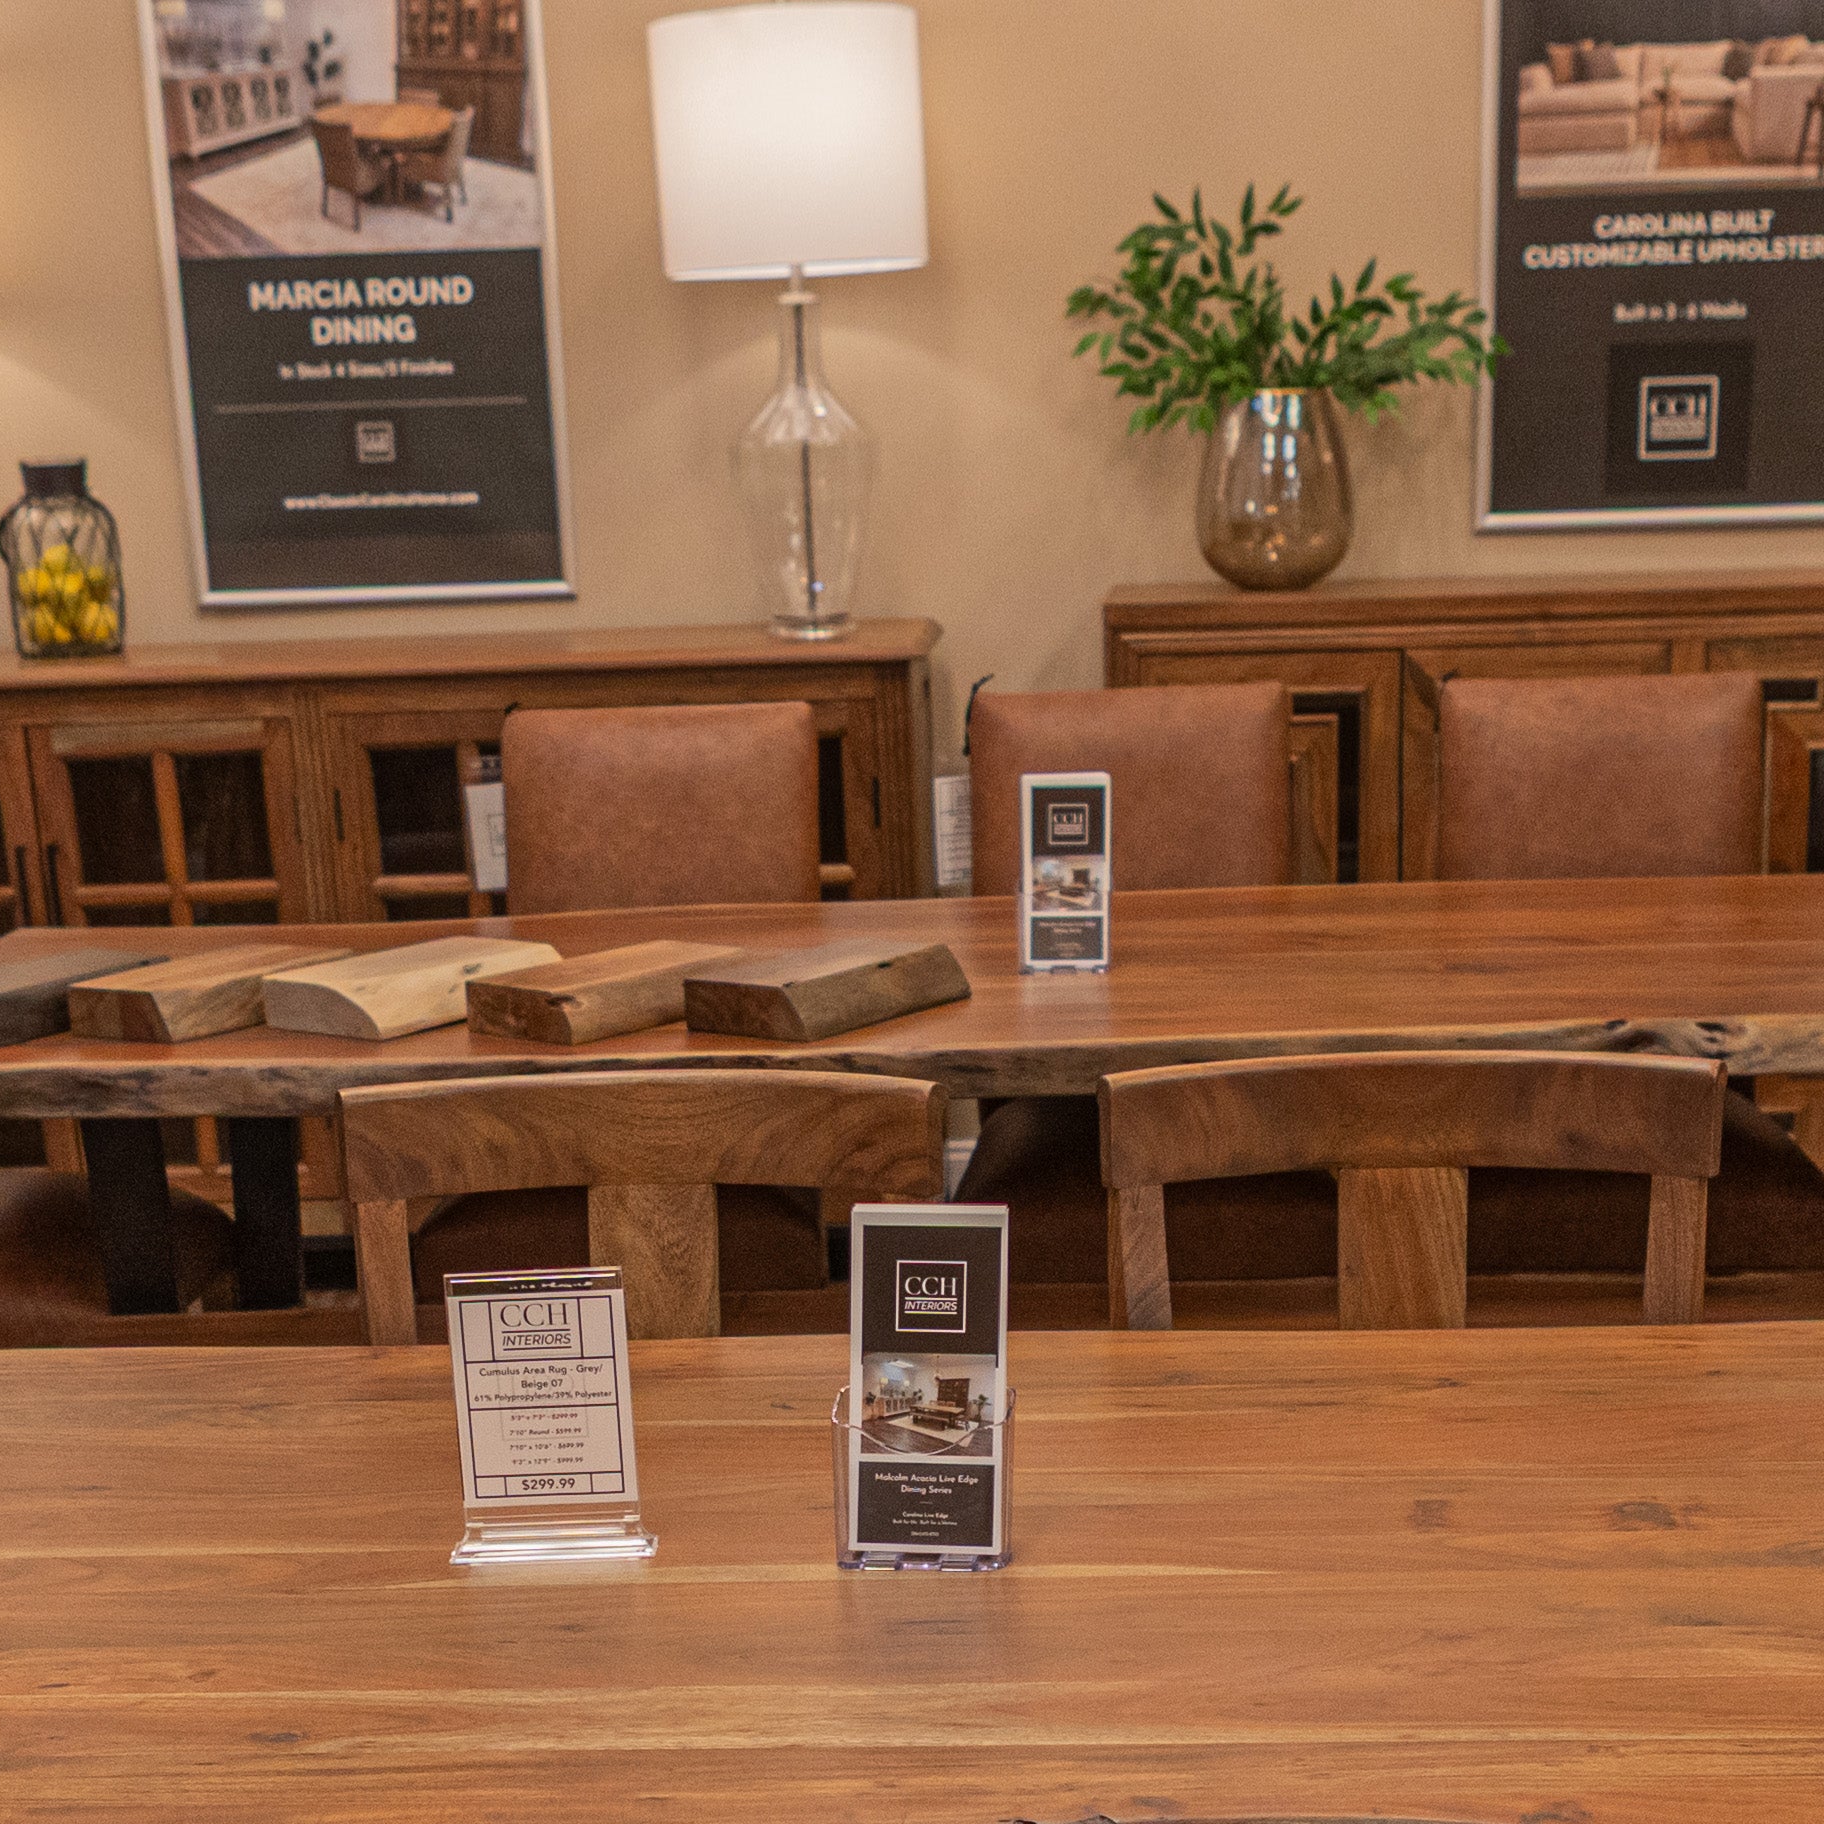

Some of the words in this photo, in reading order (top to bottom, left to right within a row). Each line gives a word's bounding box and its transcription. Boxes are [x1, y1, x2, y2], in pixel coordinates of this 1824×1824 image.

[1593, 212, 1708, 239] CAROLINA
[1710, 209, 1775, 237] BUILT
[1522, 239, 1694, 269] CUSTOMIZABLE
[249, 279, 363, 311] MARCIA
[364, 275, 474, 306] ROUND
[310, 313, 417, 346] DINING
[904, 1276, 957, 1296] CCH
[904, 1300, 958, 1311] INTERIORS
[500, 1302, 569, 1328] CCH
[502, 1333, 572, 1347] INTERIORS
[479, 1366, 521, 1377] Cumulus
[522, 1366, 546, 1375] Area
[549, 1365, 568, 1376] Rug
[576, 1364, 604, 1376] Grey/
[521, 1379, 549, 1390] Beige
[551, 1379, 564, 1388] 07
[575, 1391, 613, 1400] Polyester
[522, 1477, 576, 1491] $299.99
[875, 1473, 909, 1482] Malcolm
[910, 1474, 937, 1482] Acacia
[939, 1474, 956, 1483] Live
[958, 1475, 979, 1485] Edge
[901, 1485, 927, 1495] Dining
[929, 1485, 953, 1494] Series
